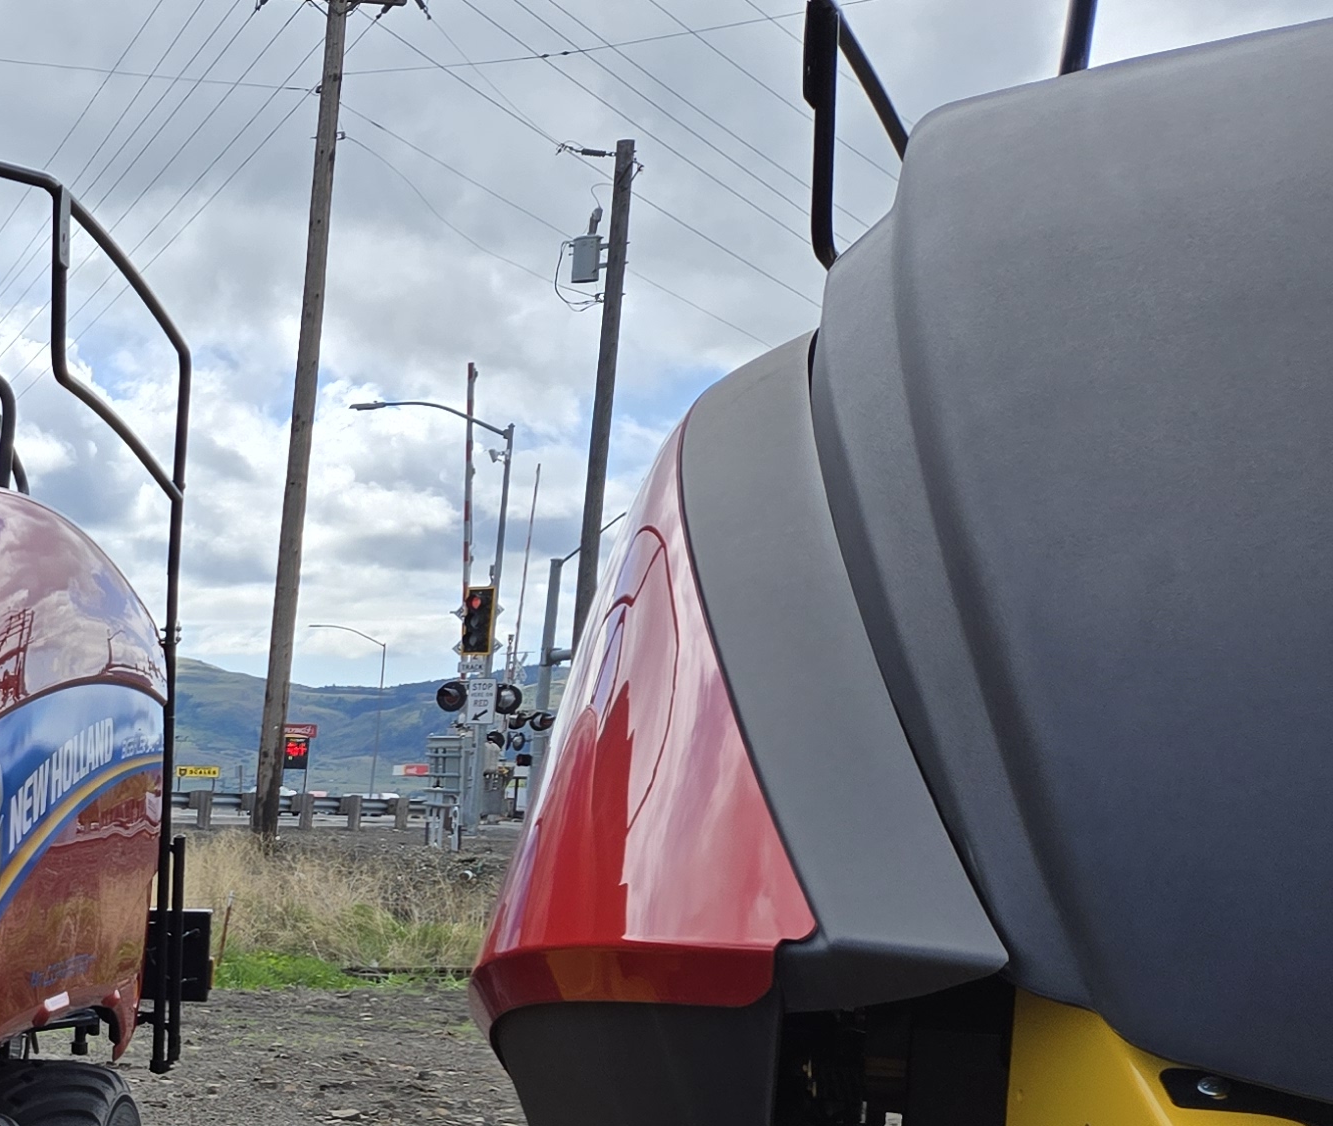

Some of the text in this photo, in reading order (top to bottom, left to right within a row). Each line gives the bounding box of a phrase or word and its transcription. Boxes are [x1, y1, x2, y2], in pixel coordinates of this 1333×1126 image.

[472, 682, 493, 691] STOP
[473, 699, 489, 708] RED
[8, 758, 50, 854] NEW
[50, 717, 114, 805] HOLLAND
